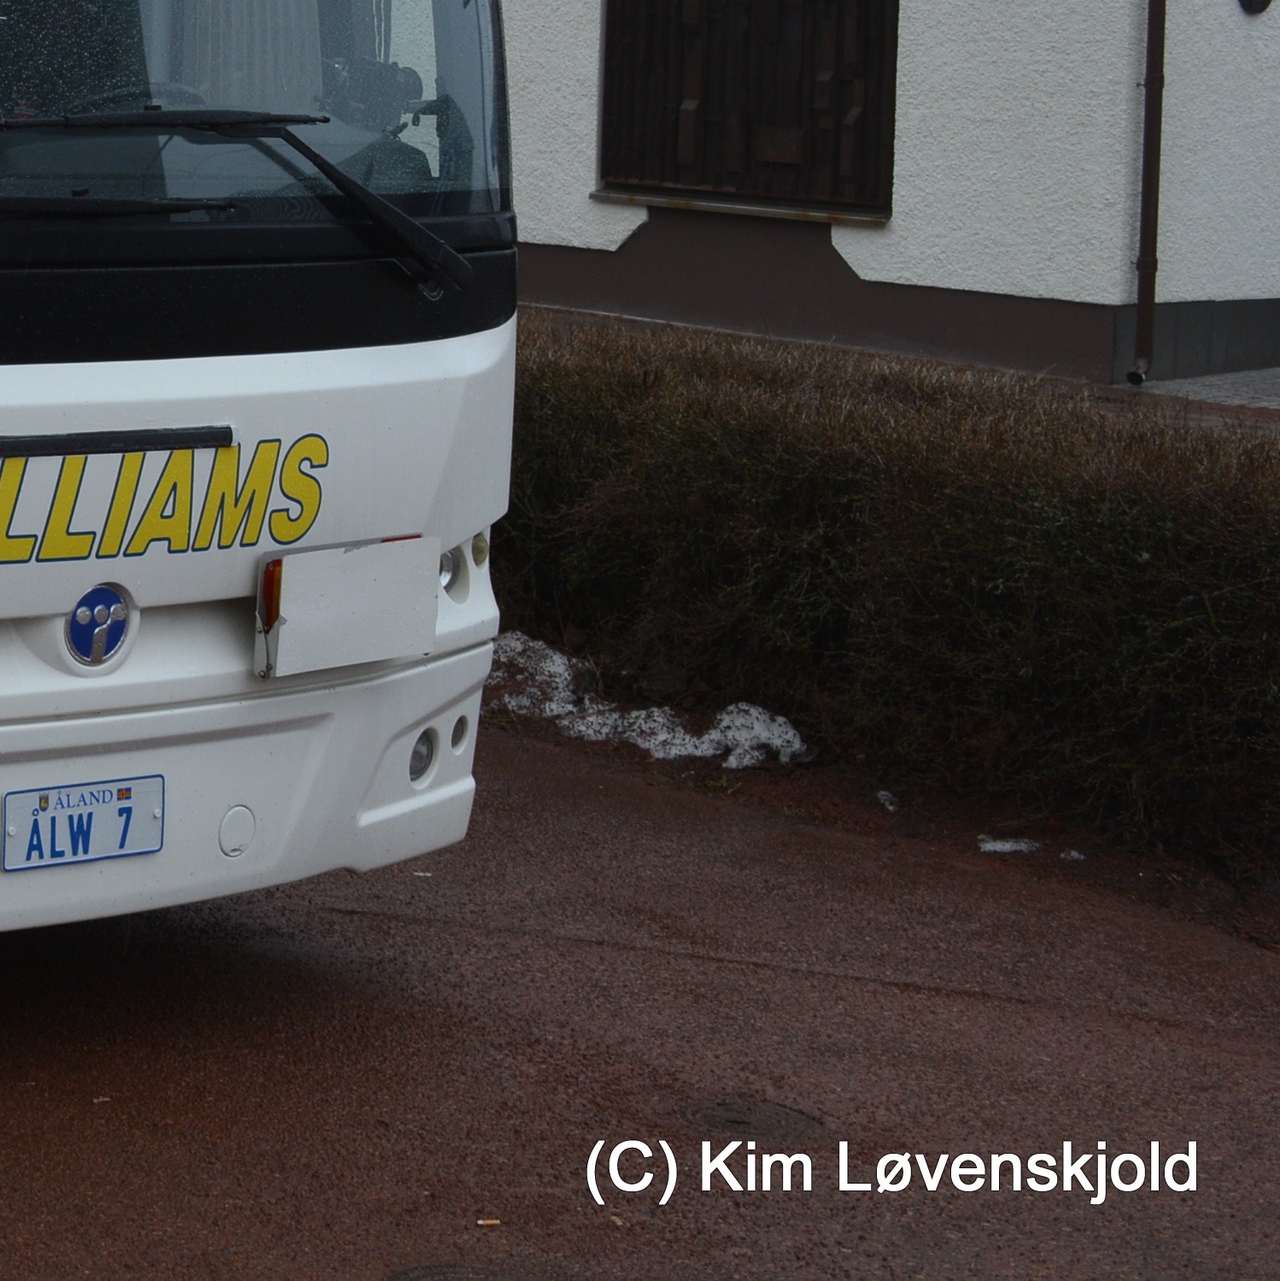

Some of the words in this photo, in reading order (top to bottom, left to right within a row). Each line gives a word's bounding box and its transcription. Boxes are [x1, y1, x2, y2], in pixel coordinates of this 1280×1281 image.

[53, 789, 114, 811] ÅLAND
[26, 807, 94, 862] ÅLW
[117, 805, 133, 850] 7
